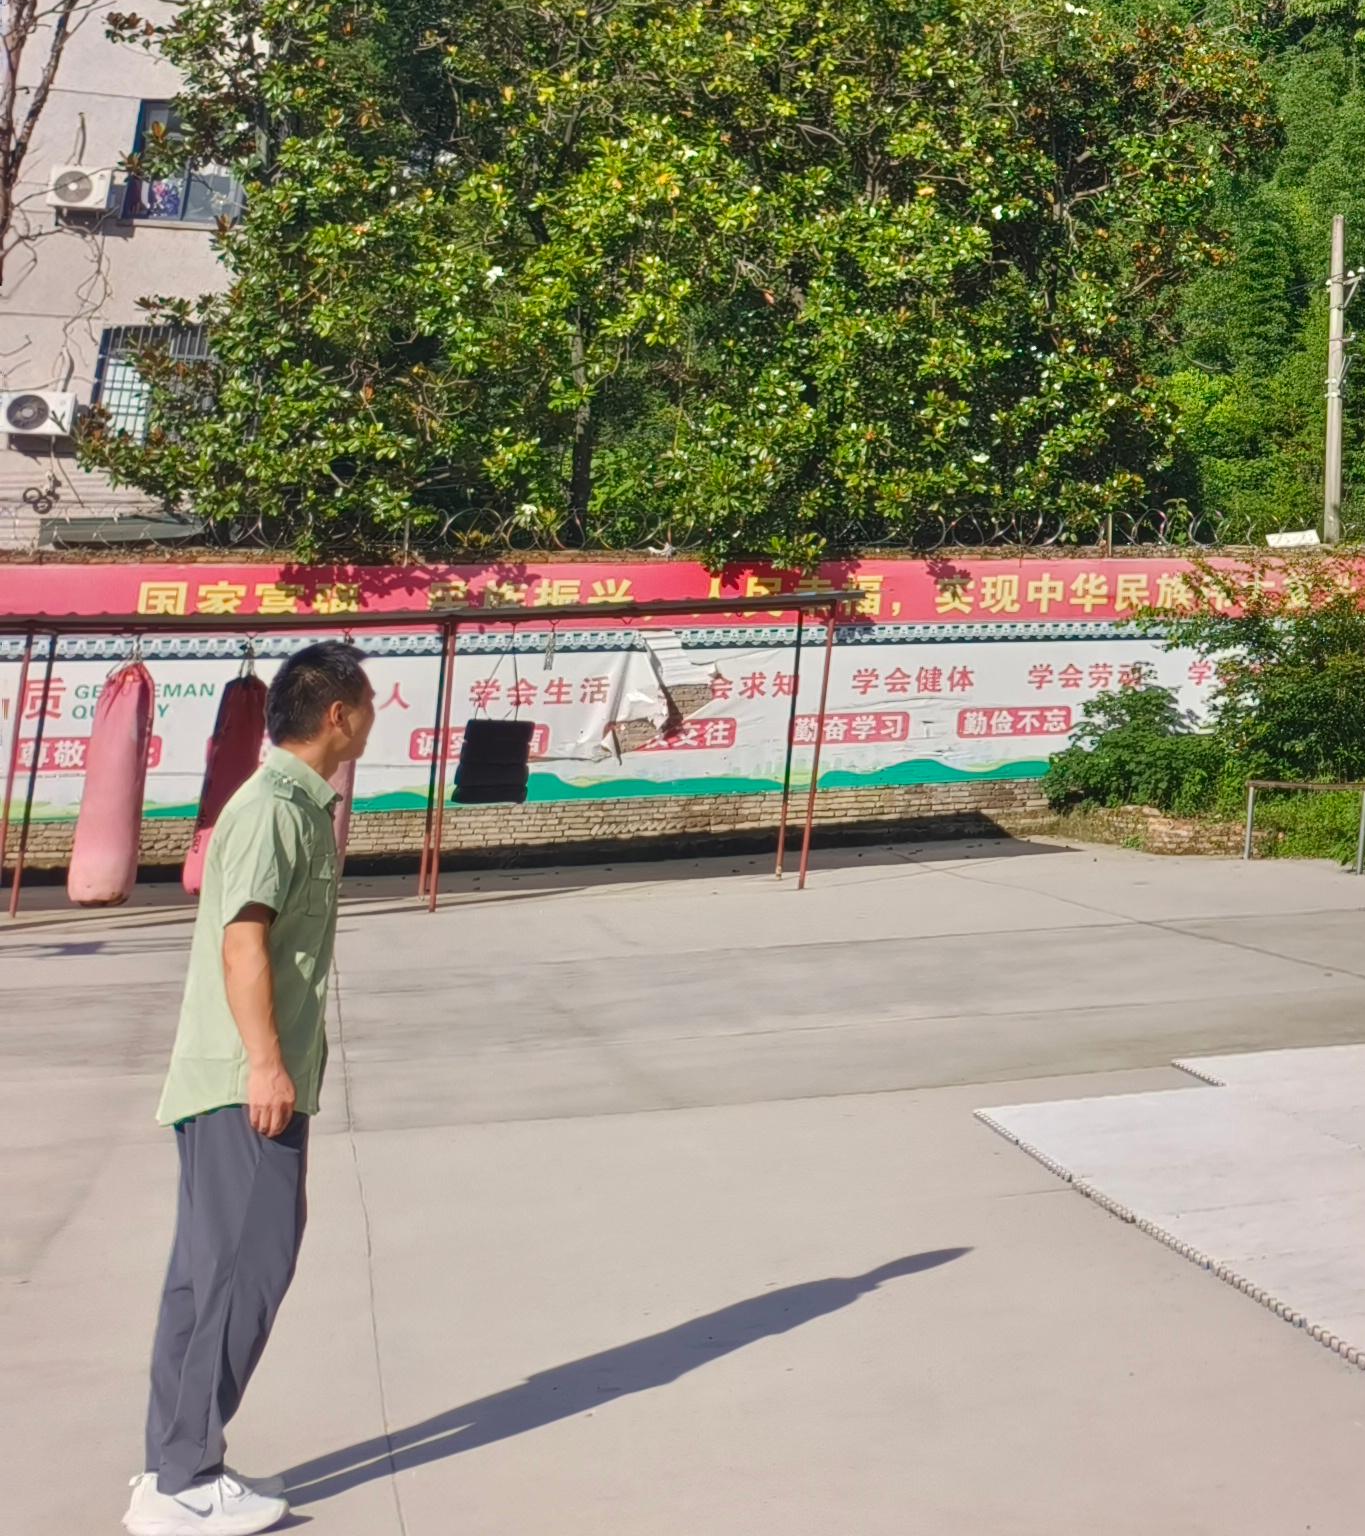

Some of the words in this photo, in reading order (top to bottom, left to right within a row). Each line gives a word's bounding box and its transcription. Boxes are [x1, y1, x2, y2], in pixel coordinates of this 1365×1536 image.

[74, 684, 215, 698] GEEMAN
[469, 676, 610, 708] 学会生活
[852, 665, 975, 695] 学会健体
[794, 716, 904, 746] 勤奋学习
[963, 710, 1068, 736] 勤俭不忘
